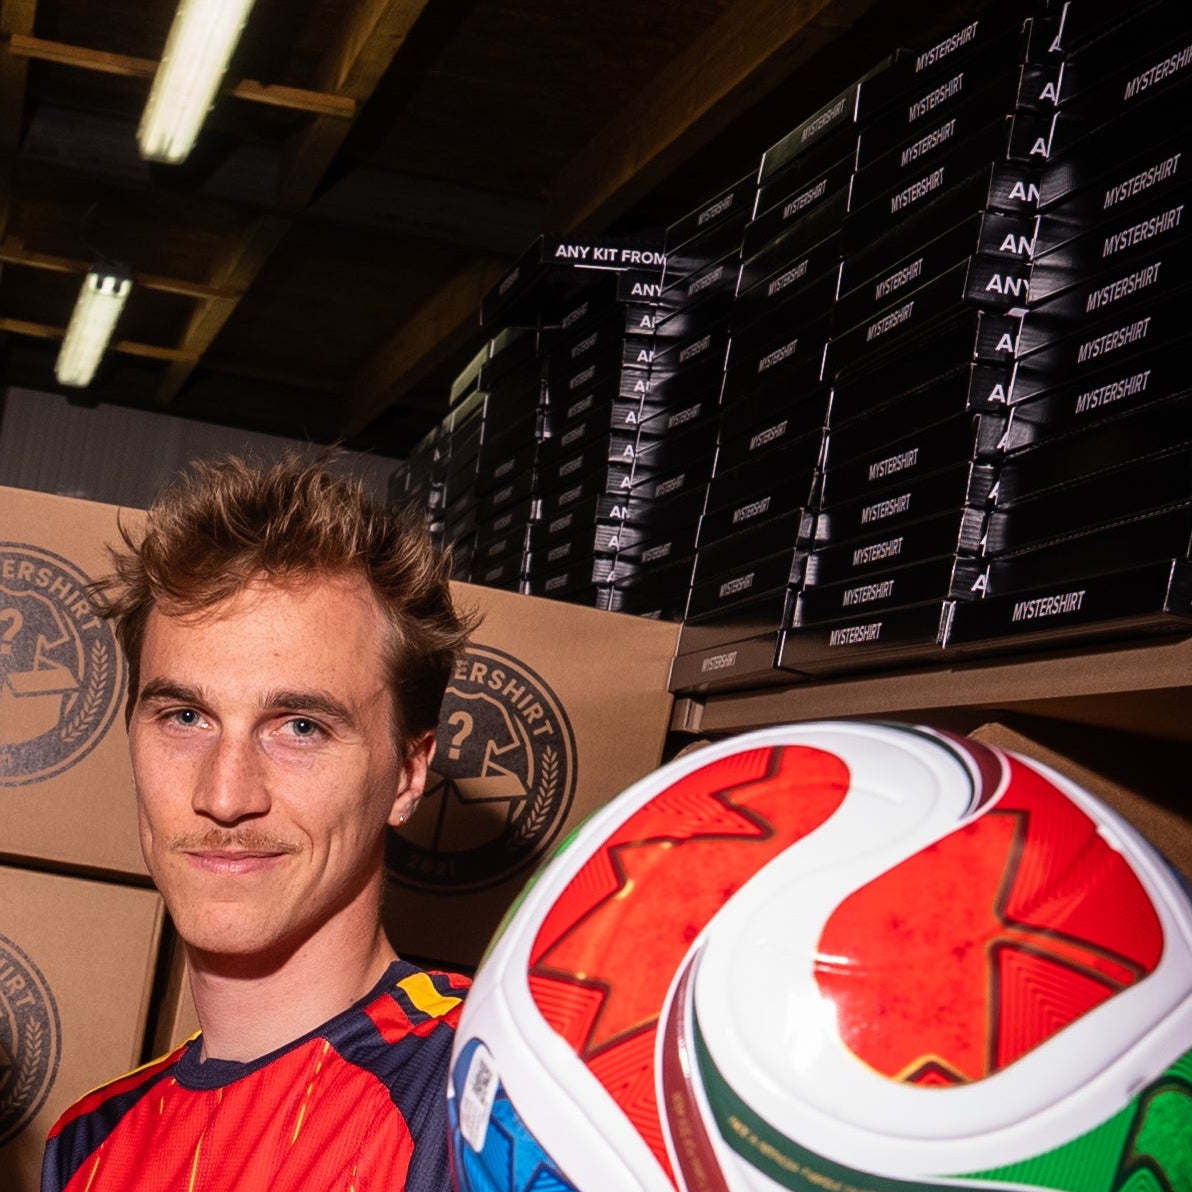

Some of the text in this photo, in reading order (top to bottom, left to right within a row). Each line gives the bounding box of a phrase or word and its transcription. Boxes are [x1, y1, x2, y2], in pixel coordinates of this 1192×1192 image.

[915, 21, 979, 73] MYSTERSHIRT
[908, 73, 964, 122] MYSTERSHIRT
[801, 98, 846, 143] MYSTERSHIRT
[901, 119, 956, 167] MYSTERSHIRT
[783, 179, 828, 220] MYSTERSHIRT
[891, 167, 945, 214] MYSTERSHIRT
[1103, 153, 1182, 210] MYSTERSHIRT
[1102, 206, 1184, 258] MYSTERSHIRT
[555, 245, 666, 265] ANY KIT FROM
[768, 259, 809, 296] MYSTERSHIRT
[875, 258, 923, 300] MYSTERSHIRT
[1086, 262, 1162, 313] MYSTERSHIRT
[867, 301, 915, 342] MYSTERSHIRT
[1078, 317, 1151, 363] MYSTERSHIRT
[758, 339, 798, 372] MYSTERSHIRT
[1075, 370, 1151, 415] MYSTERSHIRT
[868, 448, 919, 481] MYSTERSHIRT
[861, 494, 911, 524] MYSTERSHIRT
[853, 537, 904, 566] MYSTERSHIRT
[843, 580, 895, 607] MYSTERSHIRT
[1012, 590, 1085, 621] MYSTERSHIRT
[829, 623, 883, 646] MYSTERSHIRT
[454, 658, 555, 737] ERSHIRT
